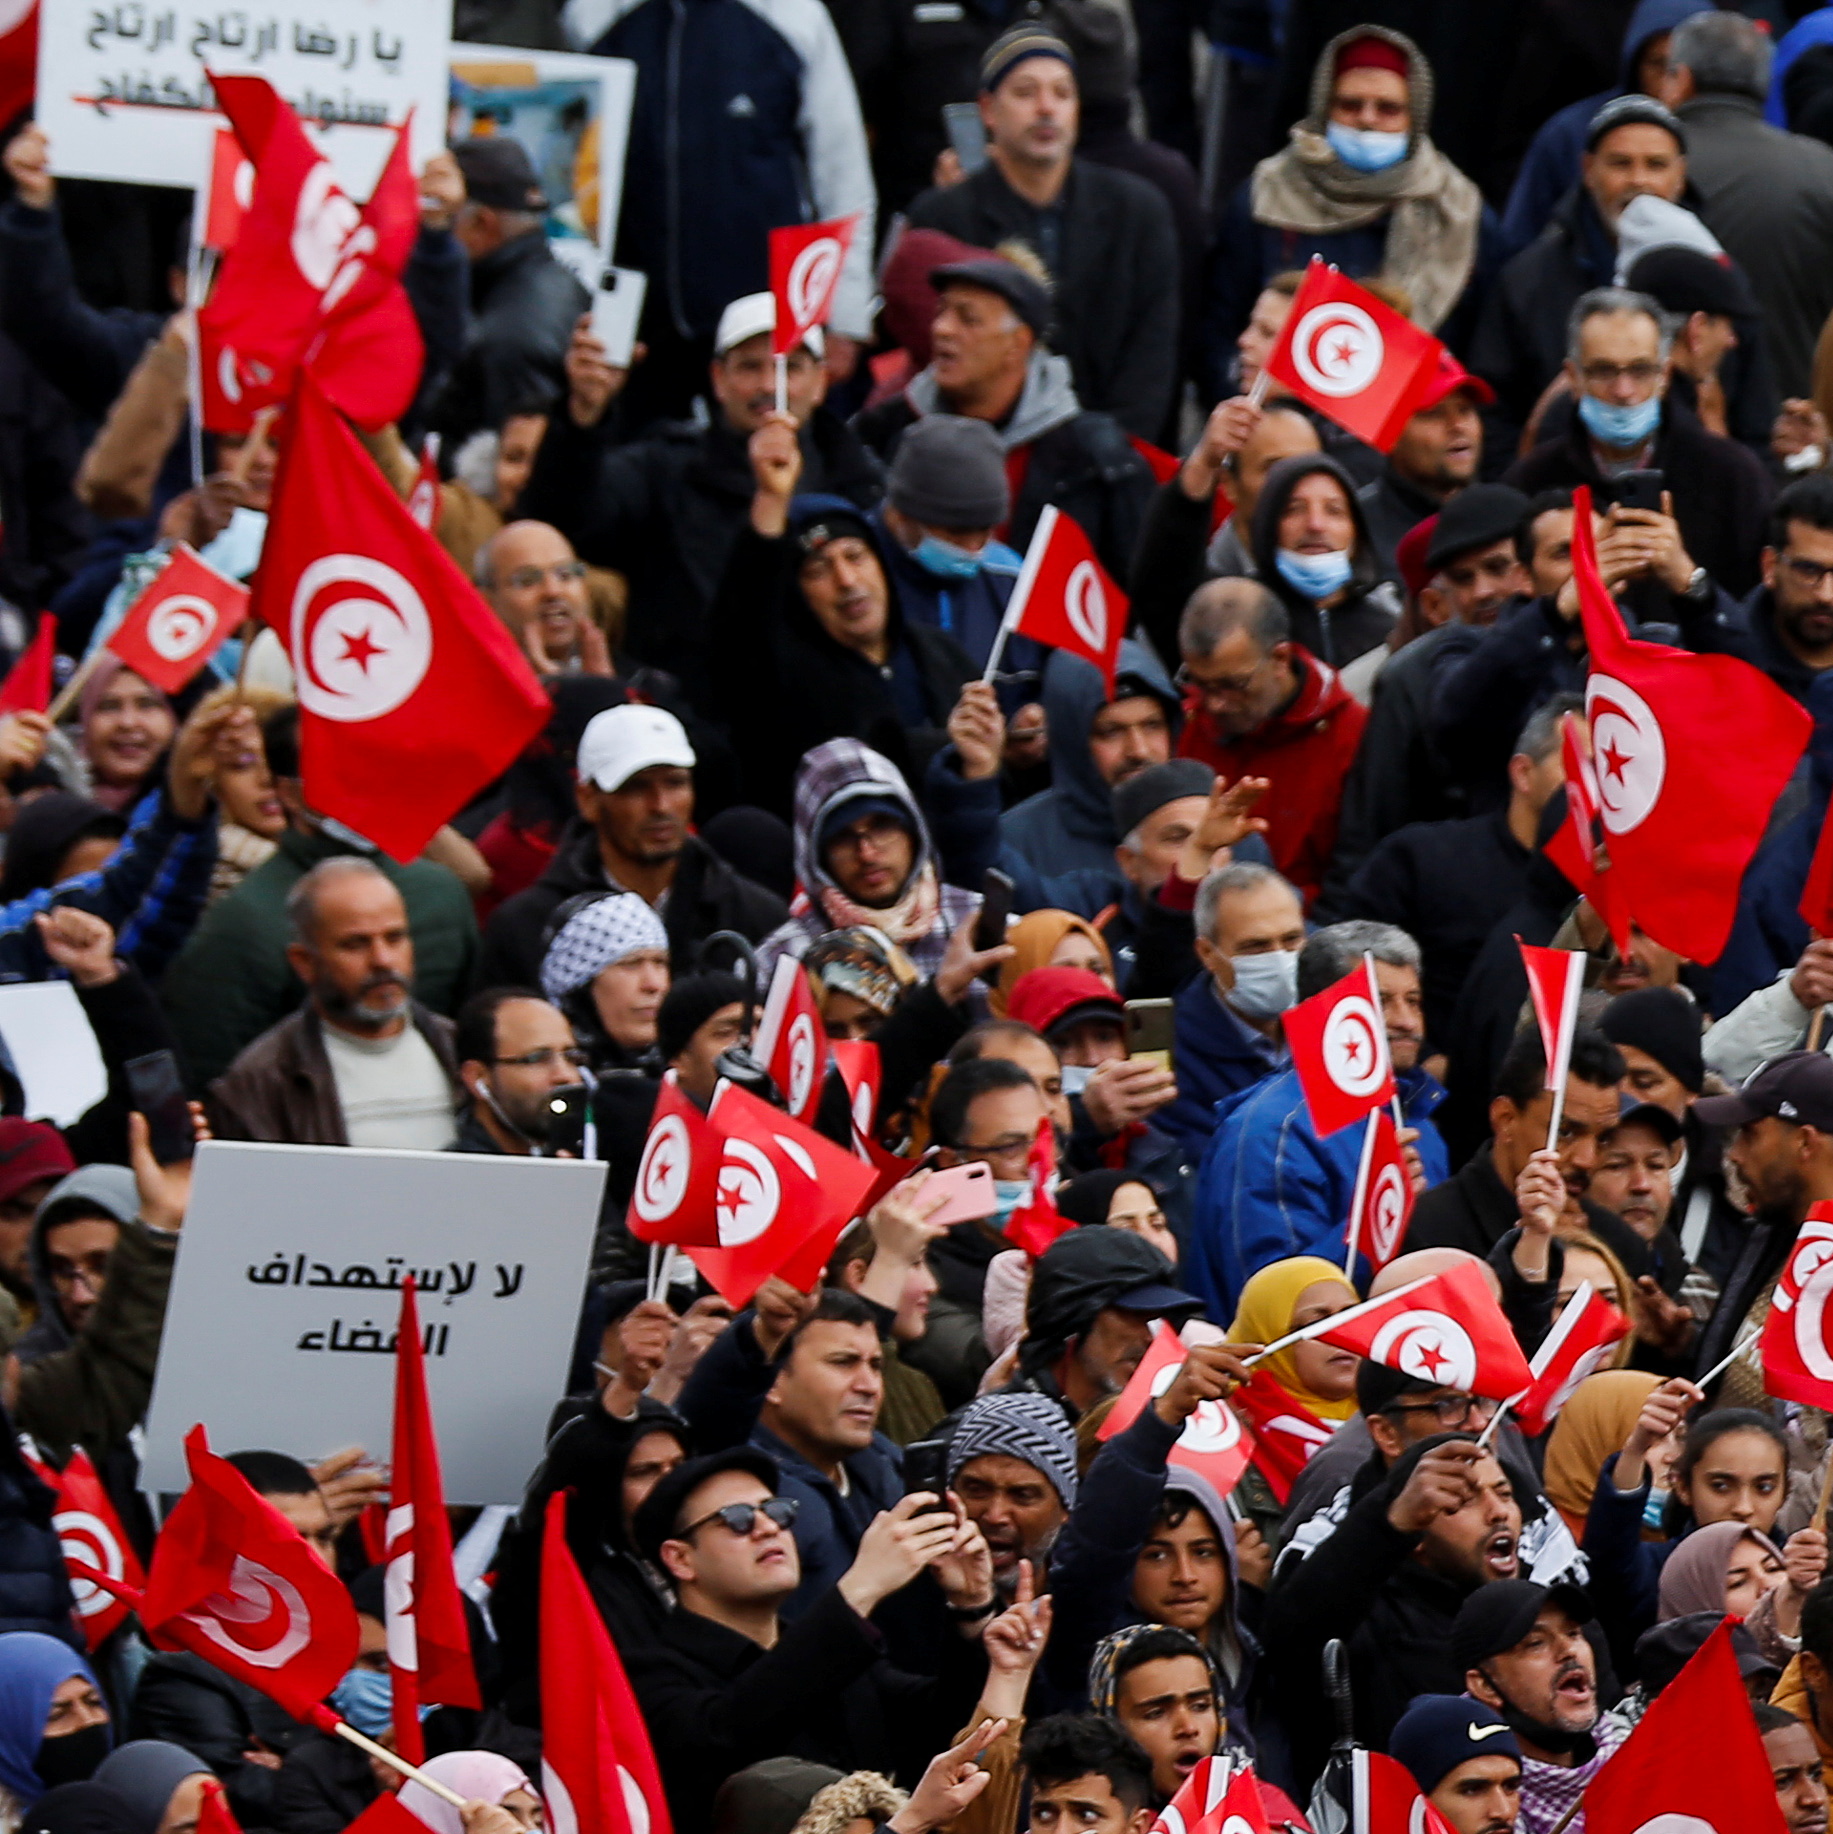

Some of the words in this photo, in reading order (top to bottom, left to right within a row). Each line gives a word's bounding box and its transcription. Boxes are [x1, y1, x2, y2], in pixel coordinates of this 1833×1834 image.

[88, 2, 174, 52] ارتاح
[191, 13, 277, 63] ارتاح
[295, 22, 356, 70] رضا
[373, 25, 403, 75] يا
[247, 1251, 476, 1306] لإستهداف
[493, 1263, 524, 1299] لا
